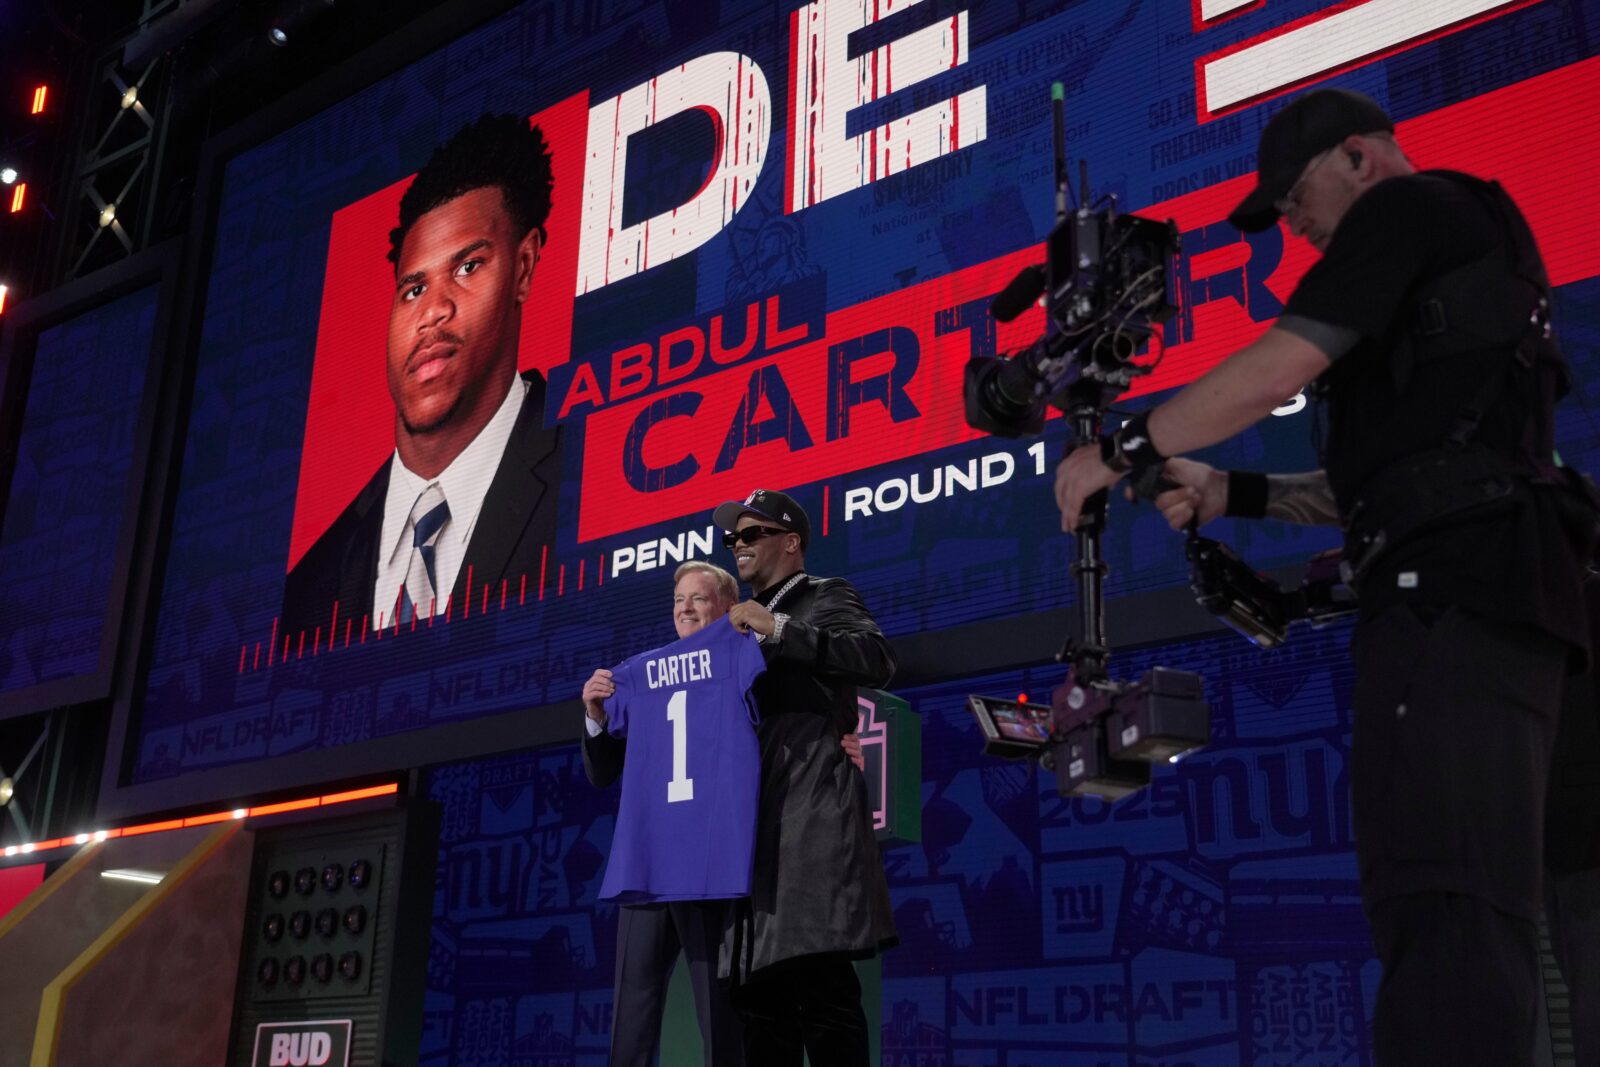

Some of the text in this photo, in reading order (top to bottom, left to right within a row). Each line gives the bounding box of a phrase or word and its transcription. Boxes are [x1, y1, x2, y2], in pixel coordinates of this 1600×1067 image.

[557, 295, 809, 420] ABDUL
[622, 217, 1287, 493] CARTR
[845, 441, 1046, 521] ROUND 1
[612, 525, 714, 578] PENN
[646, 648, 712, 689] CARTER
[481, 762, 535, 785] DRAFT
[667, 690, 694, 803] 1
[269, 1032, 331, 1066] BUD
